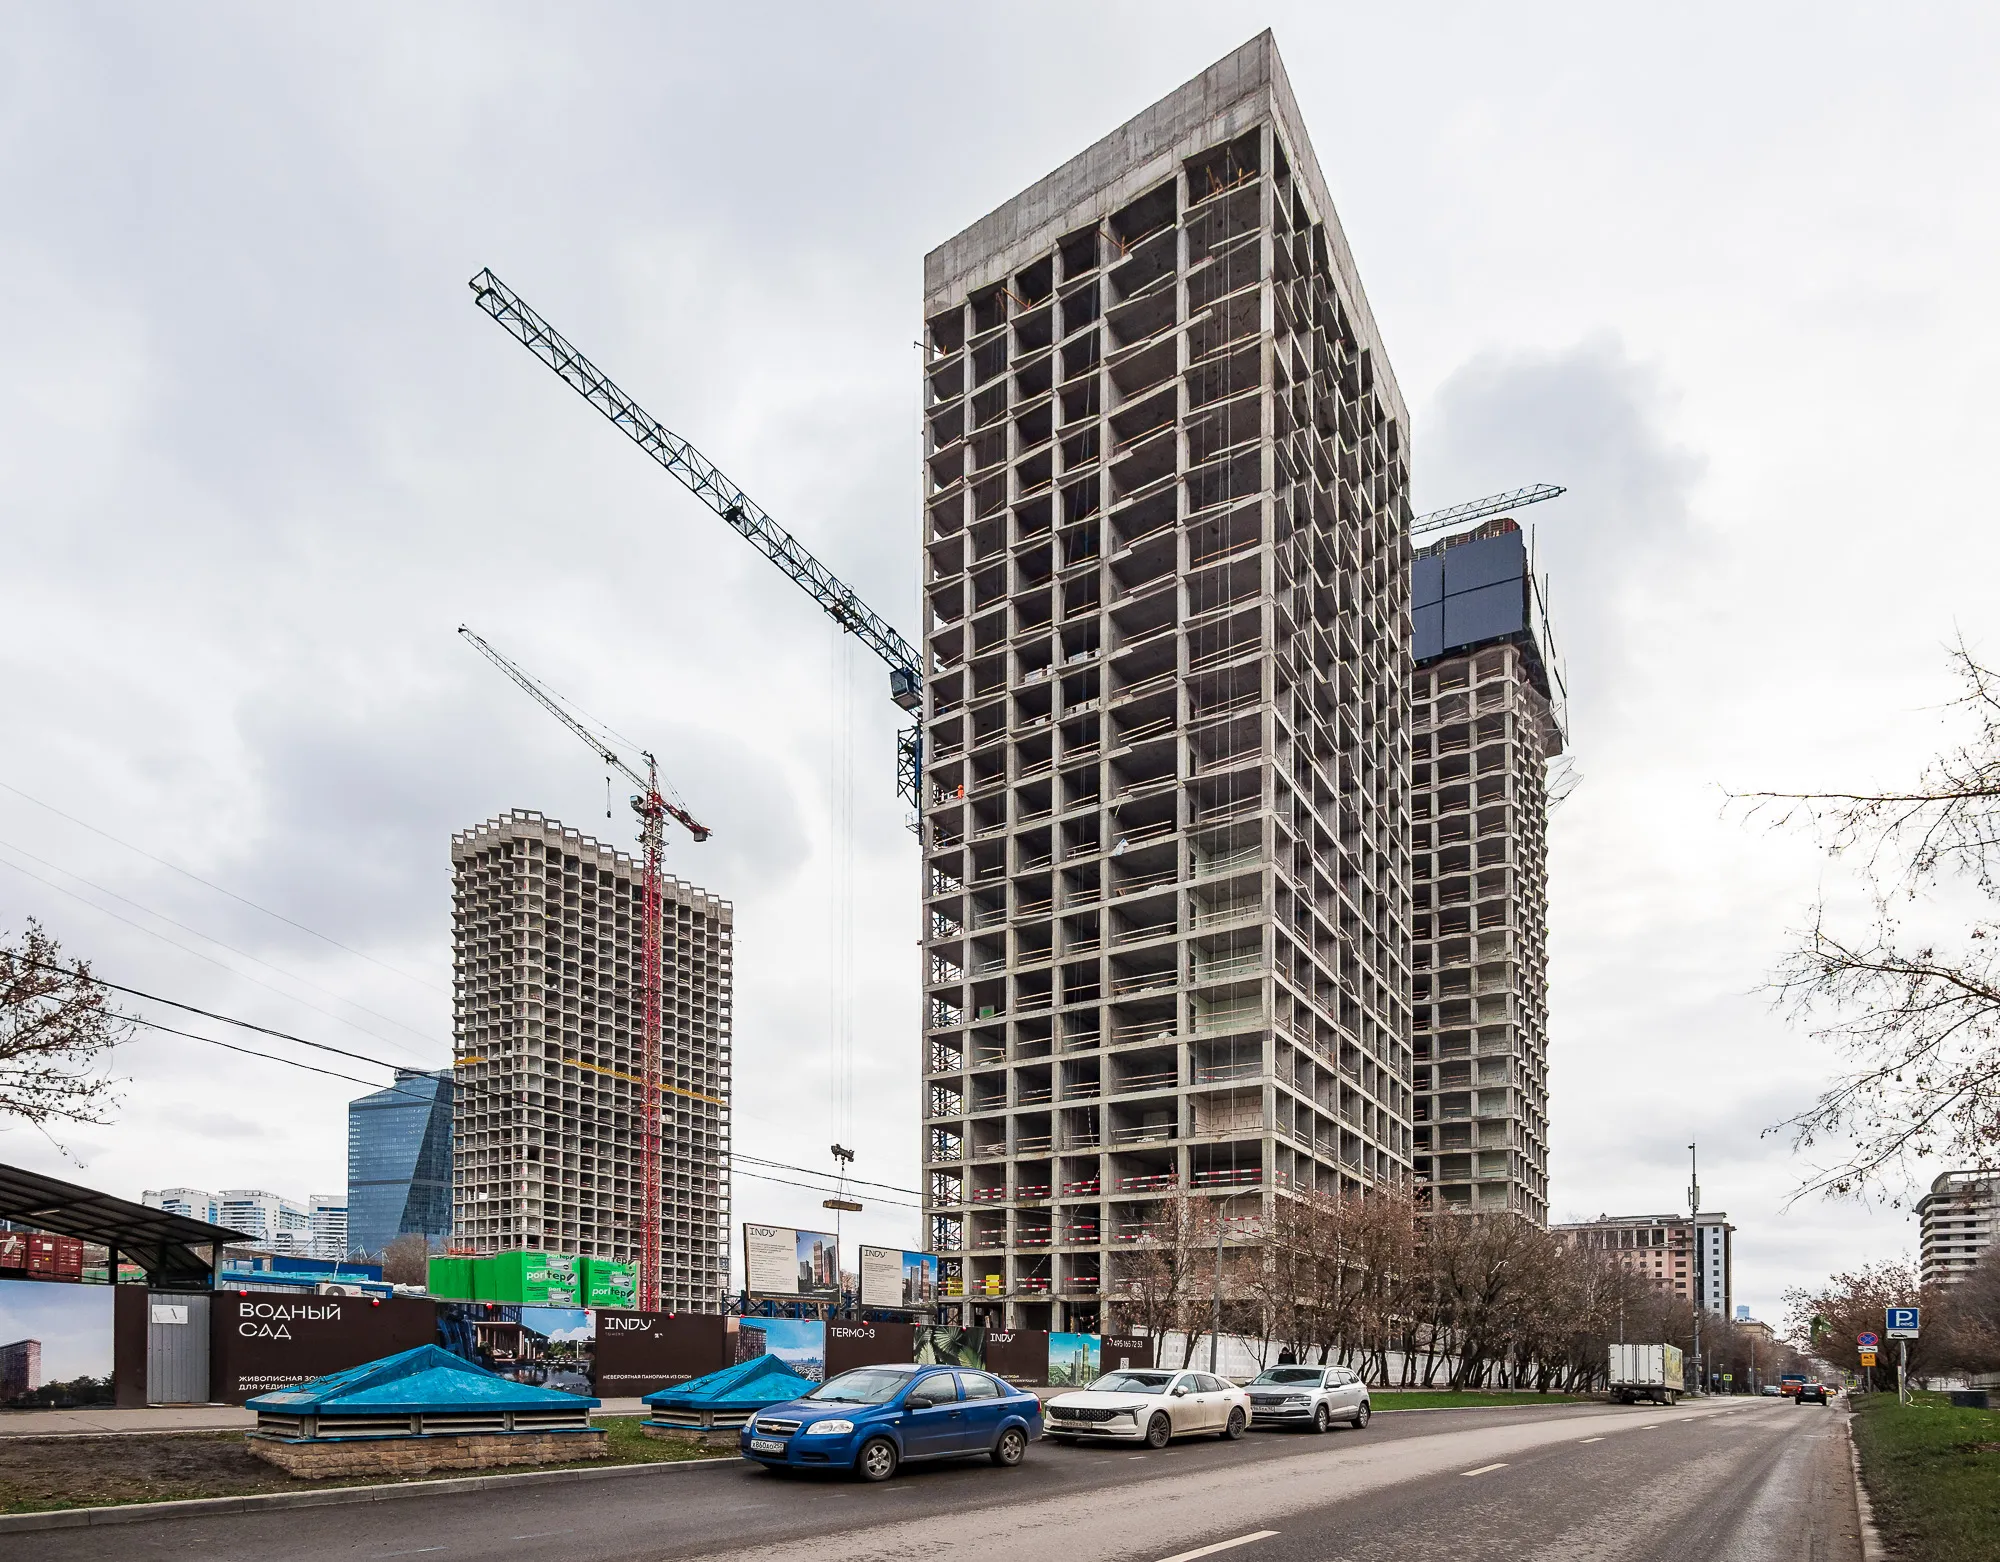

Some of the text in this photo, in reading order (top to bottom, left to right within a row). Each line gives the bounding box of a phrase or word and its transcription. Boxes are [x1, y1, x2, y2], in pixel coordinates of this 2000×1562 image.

[239, 1302, 341, 1321] ВОДНЫЙ
[1895, 1310, 1913, 1327] P
[239, 1322, 292, 1340] САД
[604, 1317, 652, 1331] INDY
[239, 1383, 258, 1391] ДЛЯ
